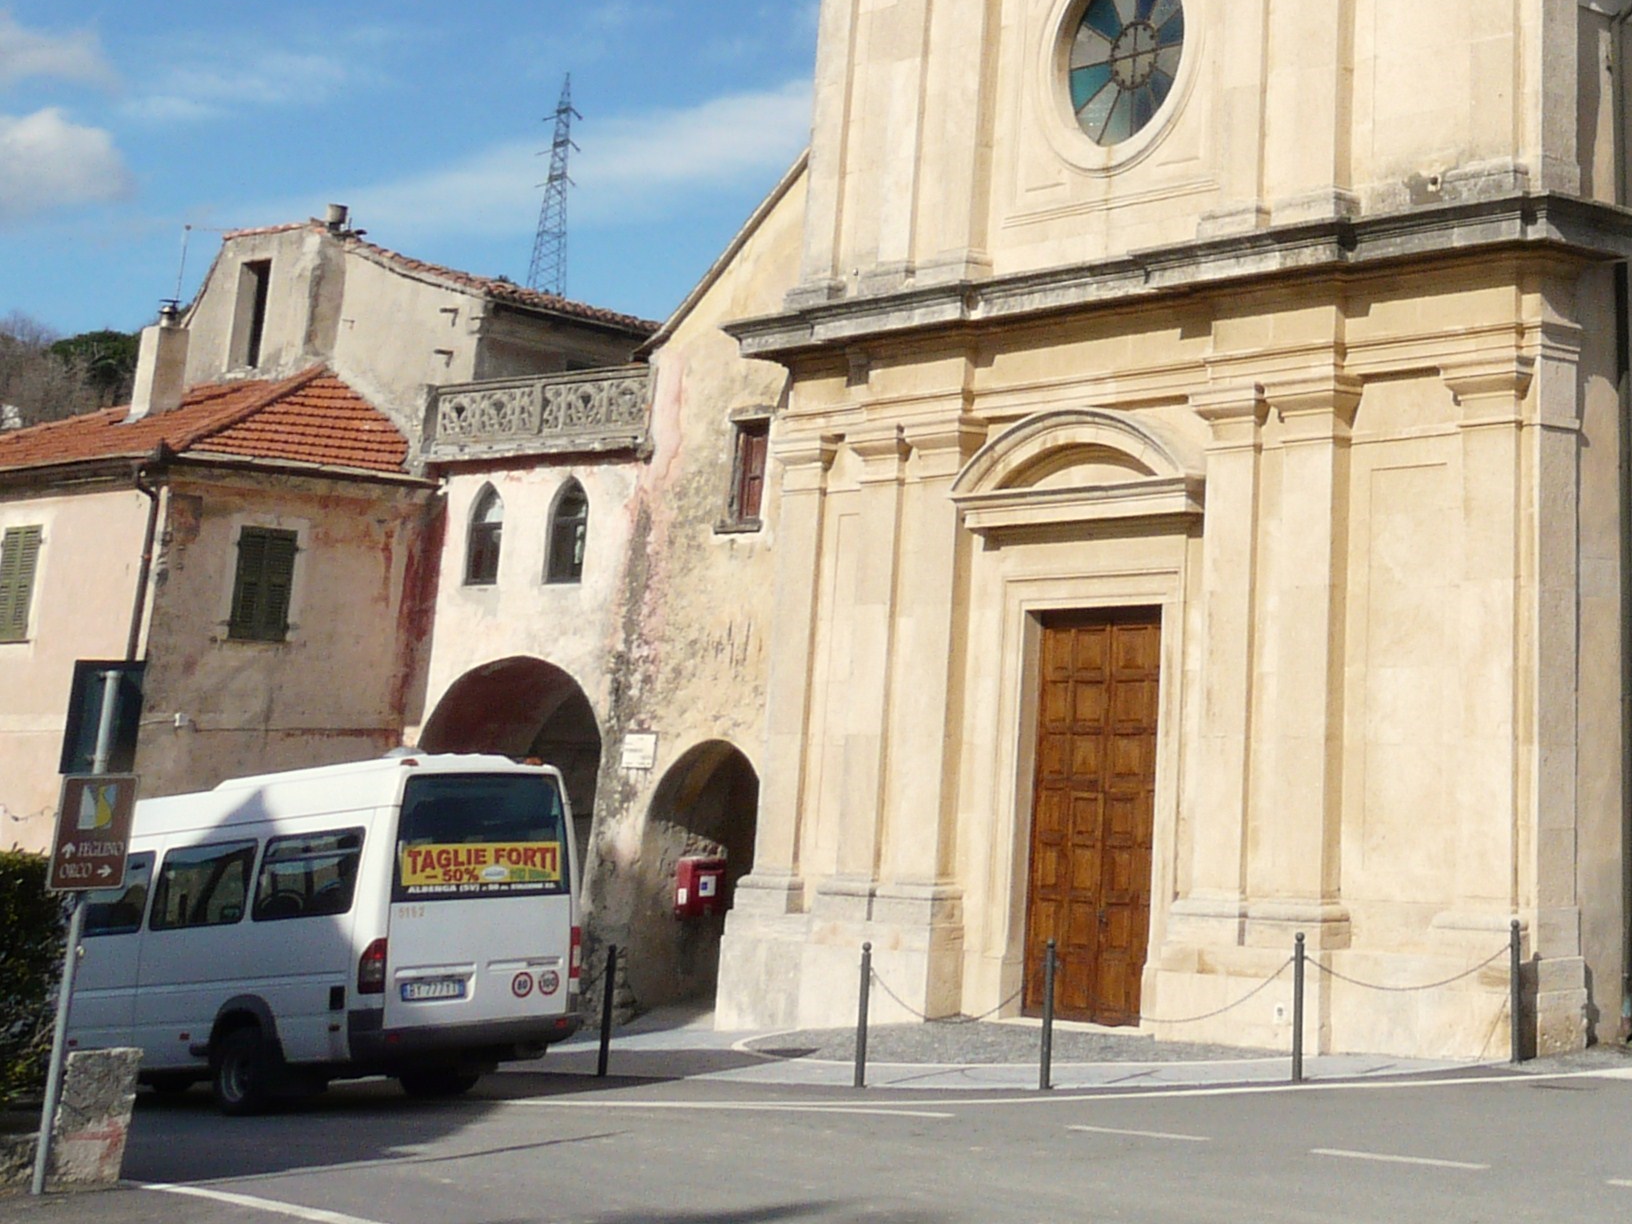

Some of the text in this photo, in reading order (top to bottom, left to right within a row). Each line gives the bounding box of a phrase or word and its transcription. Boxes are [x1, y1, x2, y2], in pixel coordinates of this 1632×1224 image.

[408, 848, 487, 875] TAGLIE
[495, 847, 556, 872] FORTI
[59, 862, 93, 878] ORCO
[408, 885, 457, 894] ALBENGA
